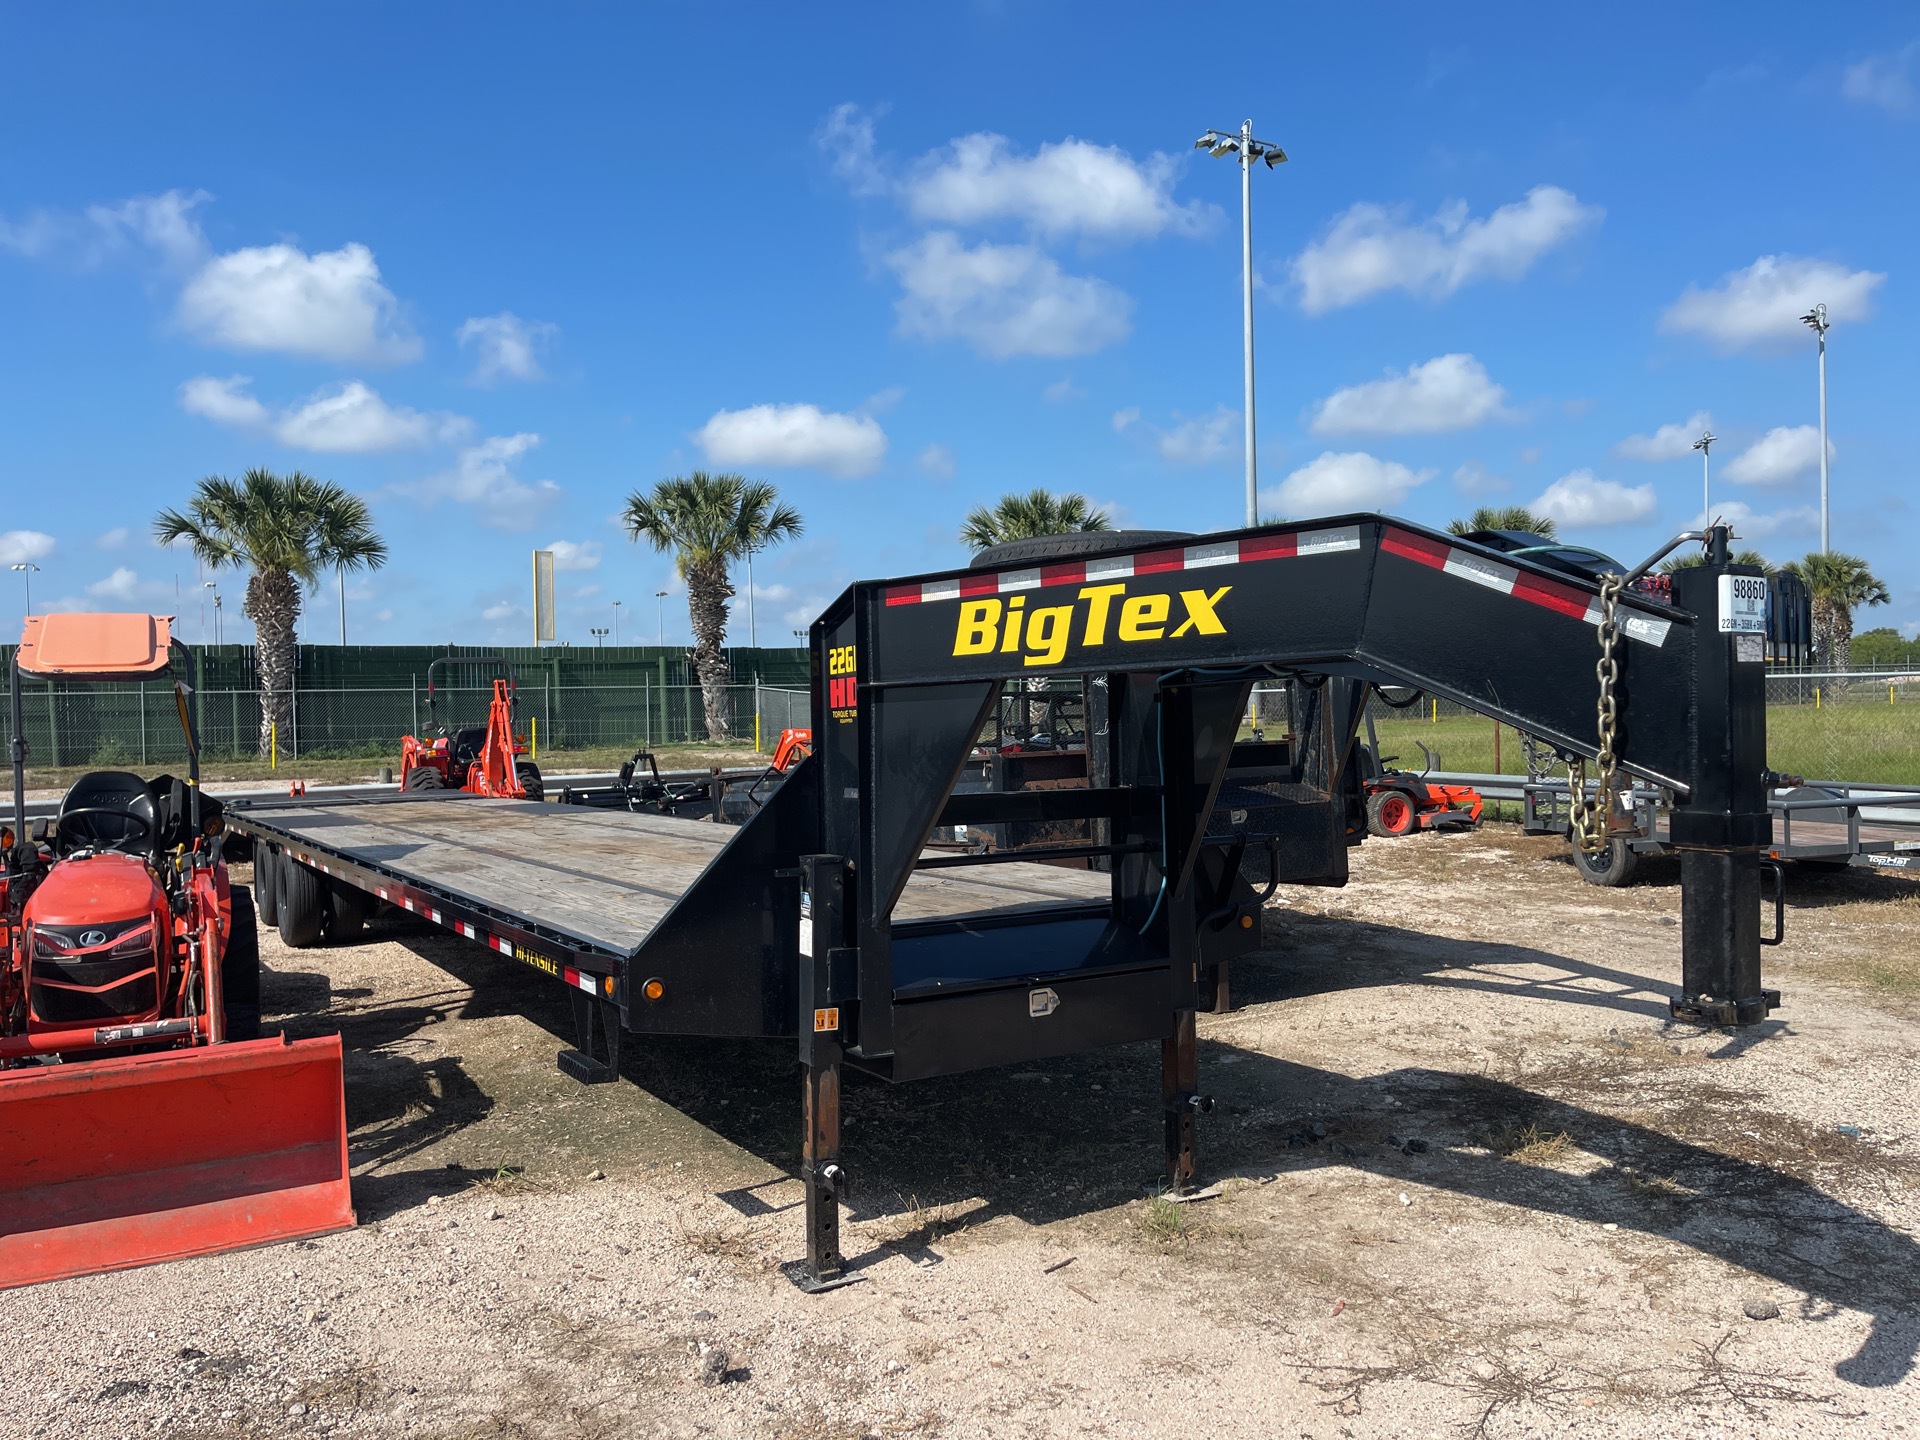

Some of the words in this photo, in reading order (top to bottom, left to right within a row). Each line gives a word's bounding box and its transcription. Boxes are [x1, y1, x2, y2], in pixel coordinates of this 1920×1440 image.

[1734, 578, 1765, 600] 98860
[952, 583, 1233, 666] BigTex
[829, 645, 857, 675] 22G
[849, 709, 857, 718] TUB
[516, 944, 558, 976] HI-TENSILE
